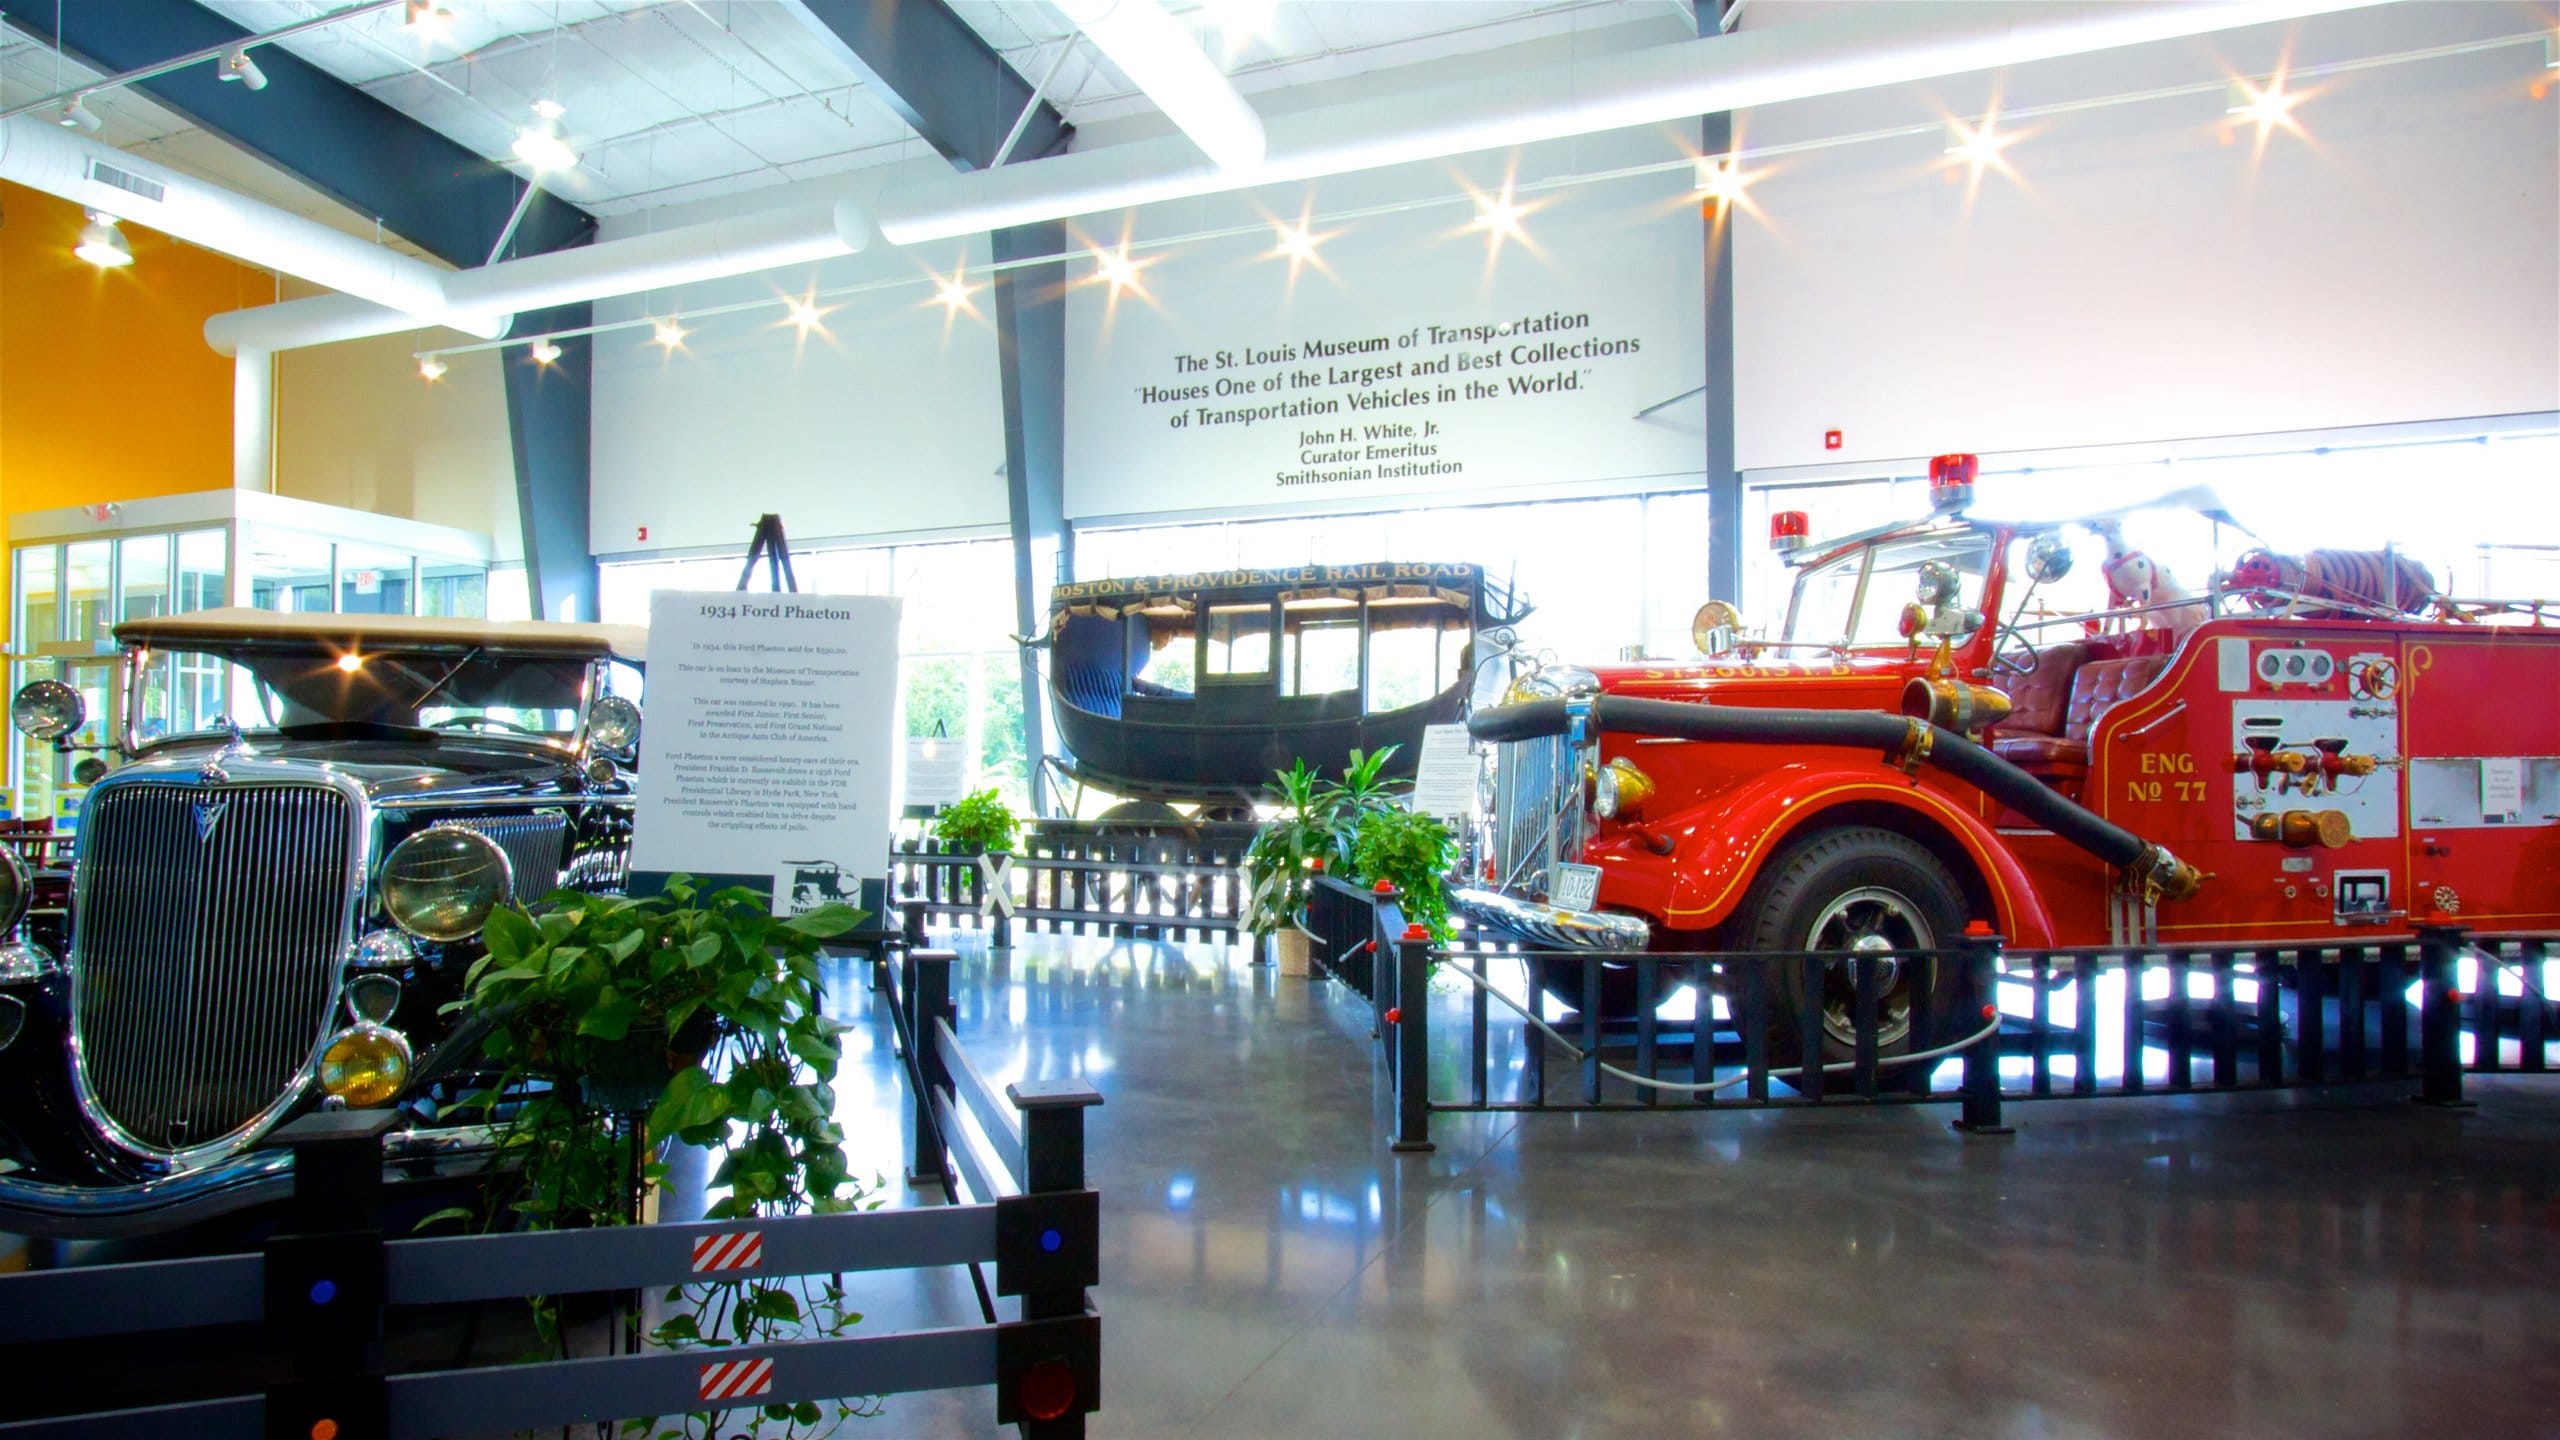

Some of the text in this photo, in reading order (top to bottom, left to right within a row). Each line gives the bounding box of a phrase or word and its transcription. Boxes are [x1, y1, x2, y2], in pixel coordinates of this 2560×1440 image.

[1175, 310, 1590, 375] The St. Louis Museum of Transportation
[1215, 376, 1257, 399] One
[1262, 370, 1284, 393] of
[1290, 369, 1322, 390] the
[1328, 362, 1403, 389] Largest
[1410, 354, 1450, 379] and
[1457, 349, 1503, 373] Best
[1510, 335, 1641, 367] Collections
[1169, 407, 1191, 430] of
[1196, 395, 1339, 427] Transportation
[1346, 386, 1431, 412] Vehicles
[1437, 382, 1457, 403] in
[1465, 378, 1500, 401] the
[1298, 420, 1440, 449] John H. White, Jr.
[1300, 441, 1438, 466] Curator Emeritus
[1276, 458, 1463, 487] Smithsonian Institution
[1053, 580, 1126, 598] BOSTON
[1133, 578, 1151, 593] &
[1158, 567, 1317, 590] PROVIDENCE
[1326, 564, 1387, 581] RAIL
[700, 604, 850, 620] 1934 Ford Phaeton
[2174, 781, 2207, 802] 77
